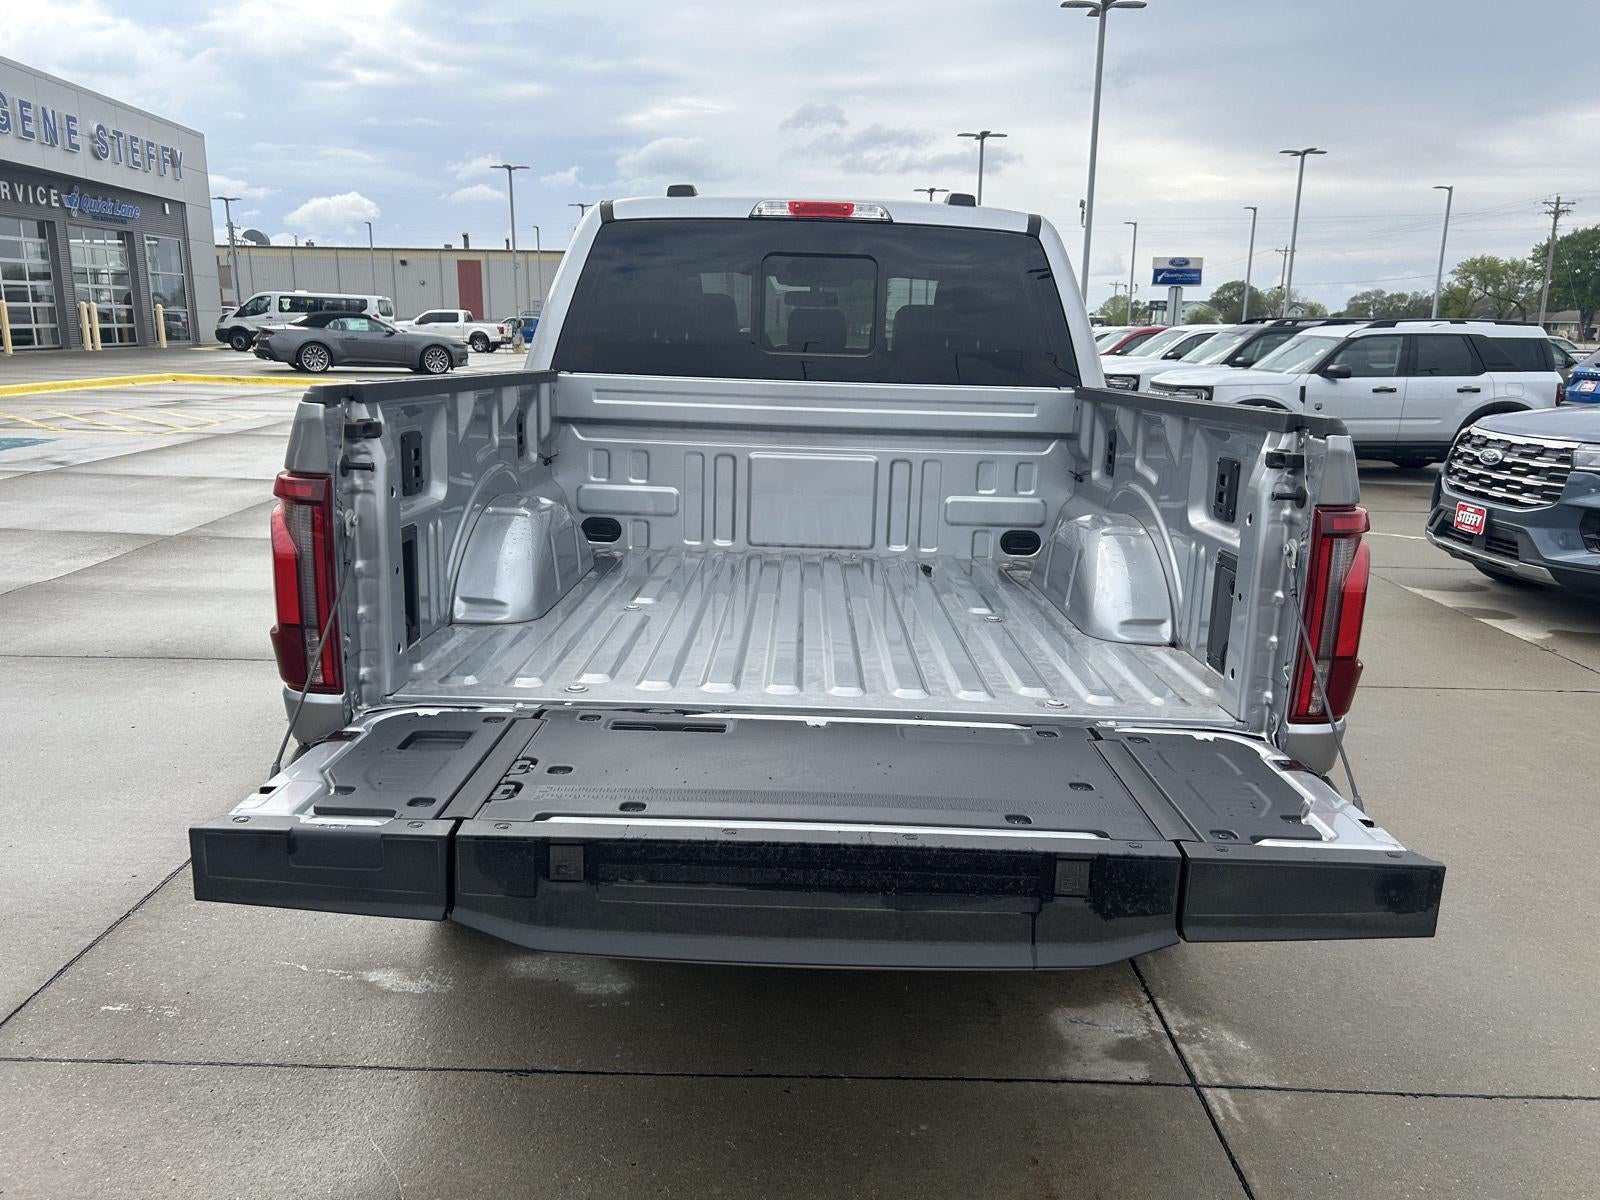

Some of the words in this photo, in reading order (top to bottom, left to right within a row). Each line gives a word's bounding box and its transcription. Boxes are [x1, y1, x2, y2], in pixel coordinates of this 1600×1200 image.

[0, 91, 80, 153] GENE
[92, 122, 183, 180] STEFFY
[81, 193, 113, 214] Quick
[114, 200, 140, 218] Lane
[1457, 510, 1482, 527] STEFFY
